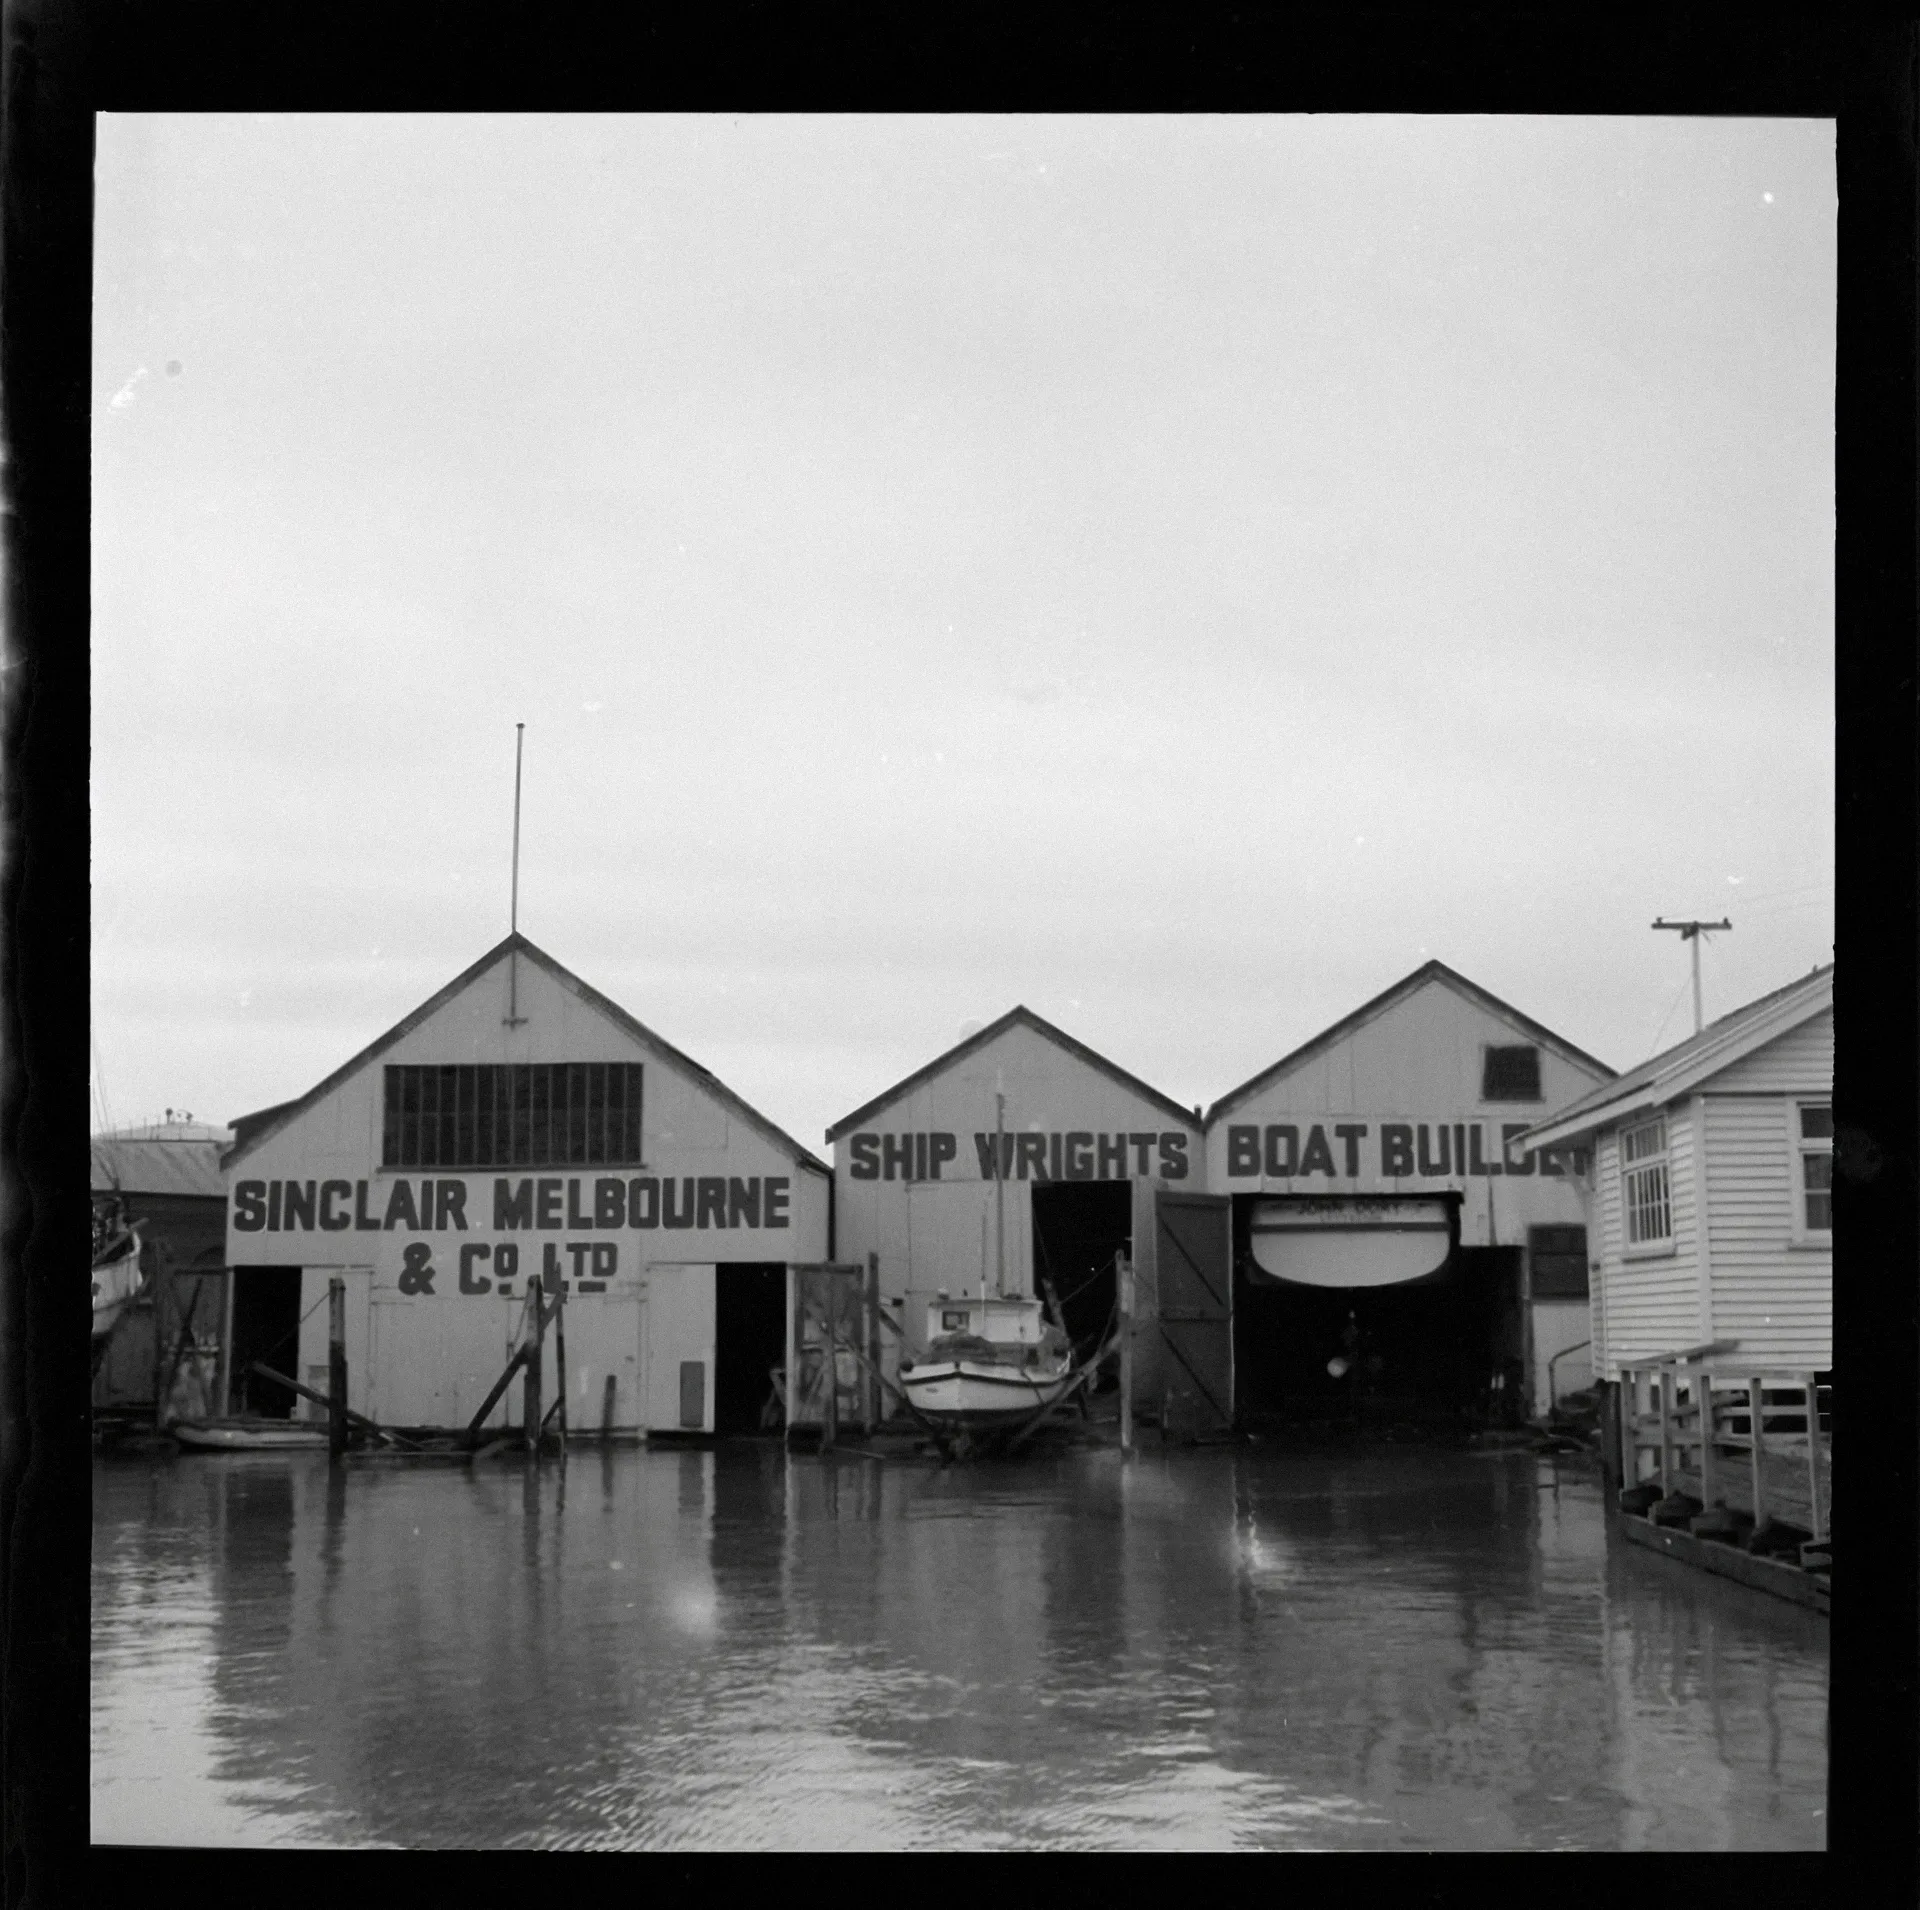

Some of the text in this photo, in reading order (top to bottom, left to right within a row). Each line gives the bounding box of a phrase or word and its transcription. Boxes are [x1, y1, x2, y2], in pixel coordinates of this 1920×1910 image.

[849, 1132, 1190, 1181] SHIP WRIGHTS
[1227, 1124, 1368, 1178] BOAT
[233, 1177, 790, 1232] SINCLAIR MELBOURNE
[398, 1241, 436, 1296] &
